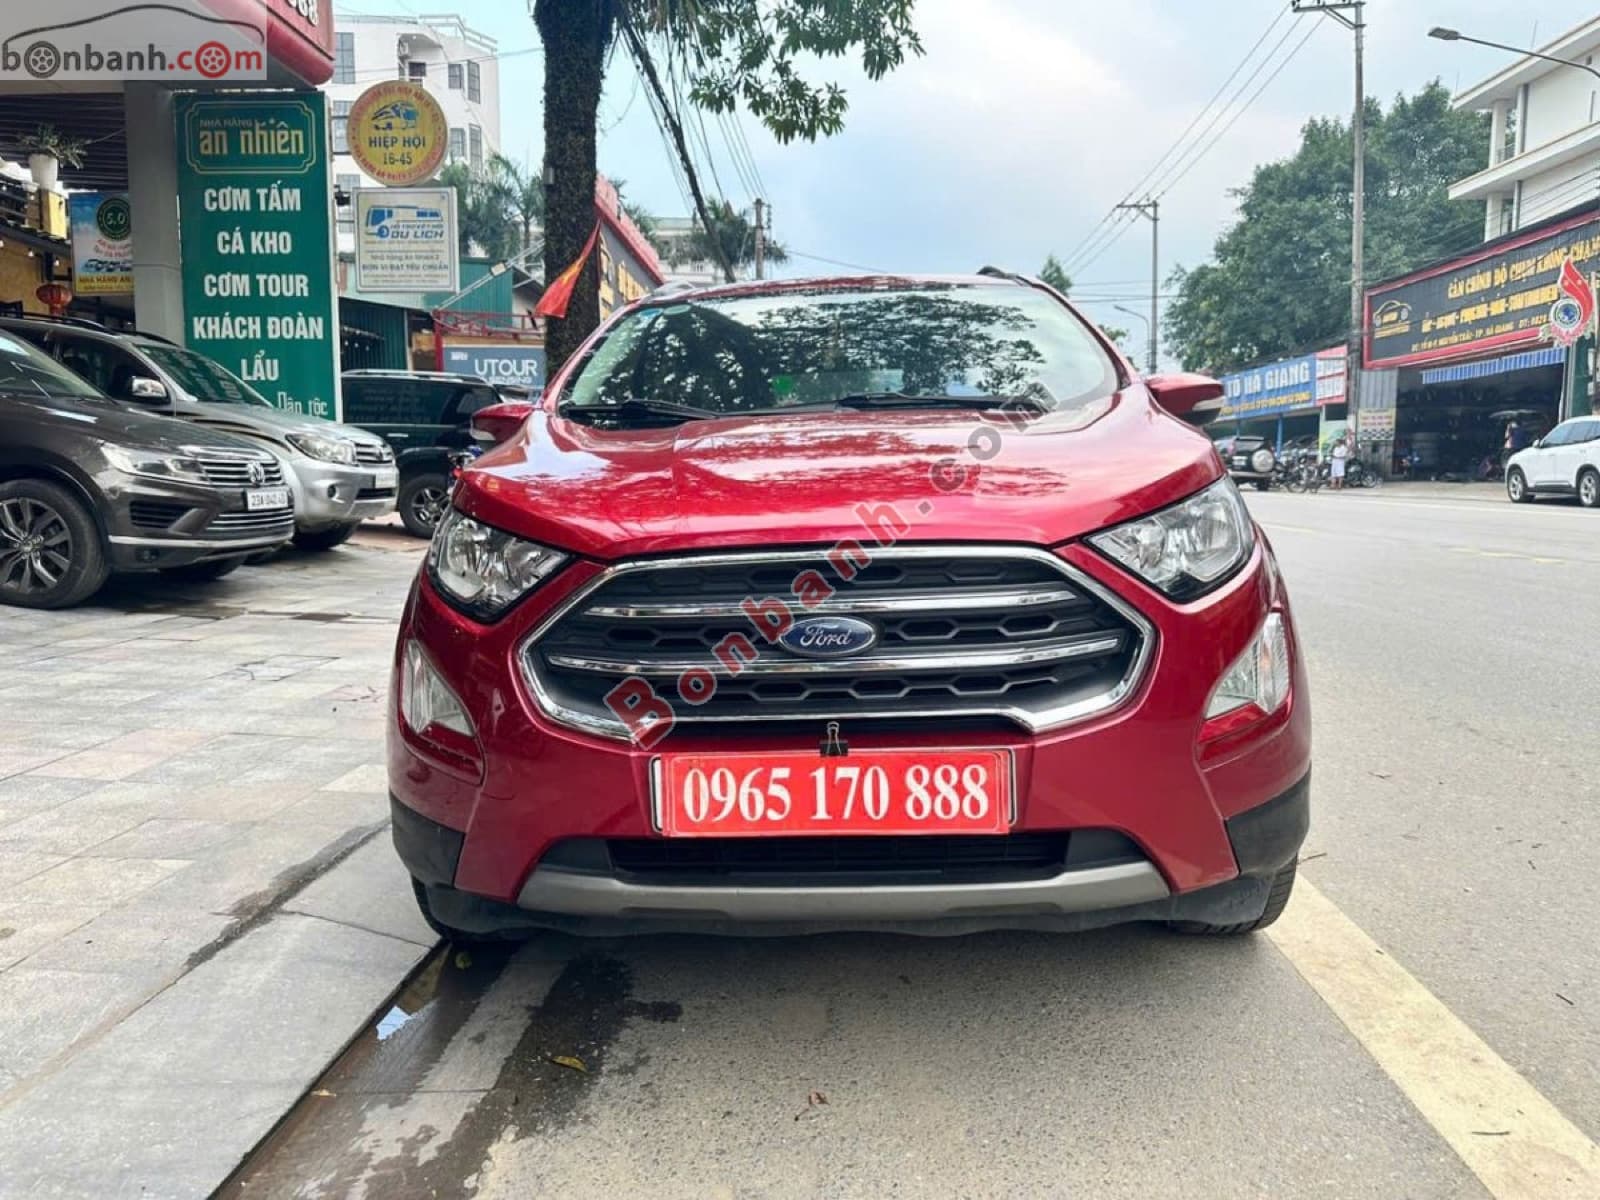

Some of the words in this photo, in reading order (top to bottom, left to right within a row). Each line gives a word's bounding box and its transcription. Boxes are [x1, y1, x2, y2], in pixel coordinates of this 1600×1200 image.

[199, 129, 229, 155] an
[240, 118, 304, 155] nhiên
[204, 186, 251, 212] CƠM
[256, 180, 302, 212] TẤM
[216, 227, 245, 254] CÁ
[250, 231, 292, 255] KHO
[204, 272, 250, 297] CƠM
[256, 274, 309, 297] TOUR
[193, 312, 261, 339] KHÁCH
[267, 312, 324, 339] ĐOÀN
[241, 350, 280, 381] LẨU
[474, 358, 538, 377] UTOUR
[1265, 361, 1310, 390] GIANG
[800, 623, 852, 647] Ford
[683, 766, 792, 822] 0965
[809, 765, 890, 821] 170
[905, 764, 989, 821] 888
